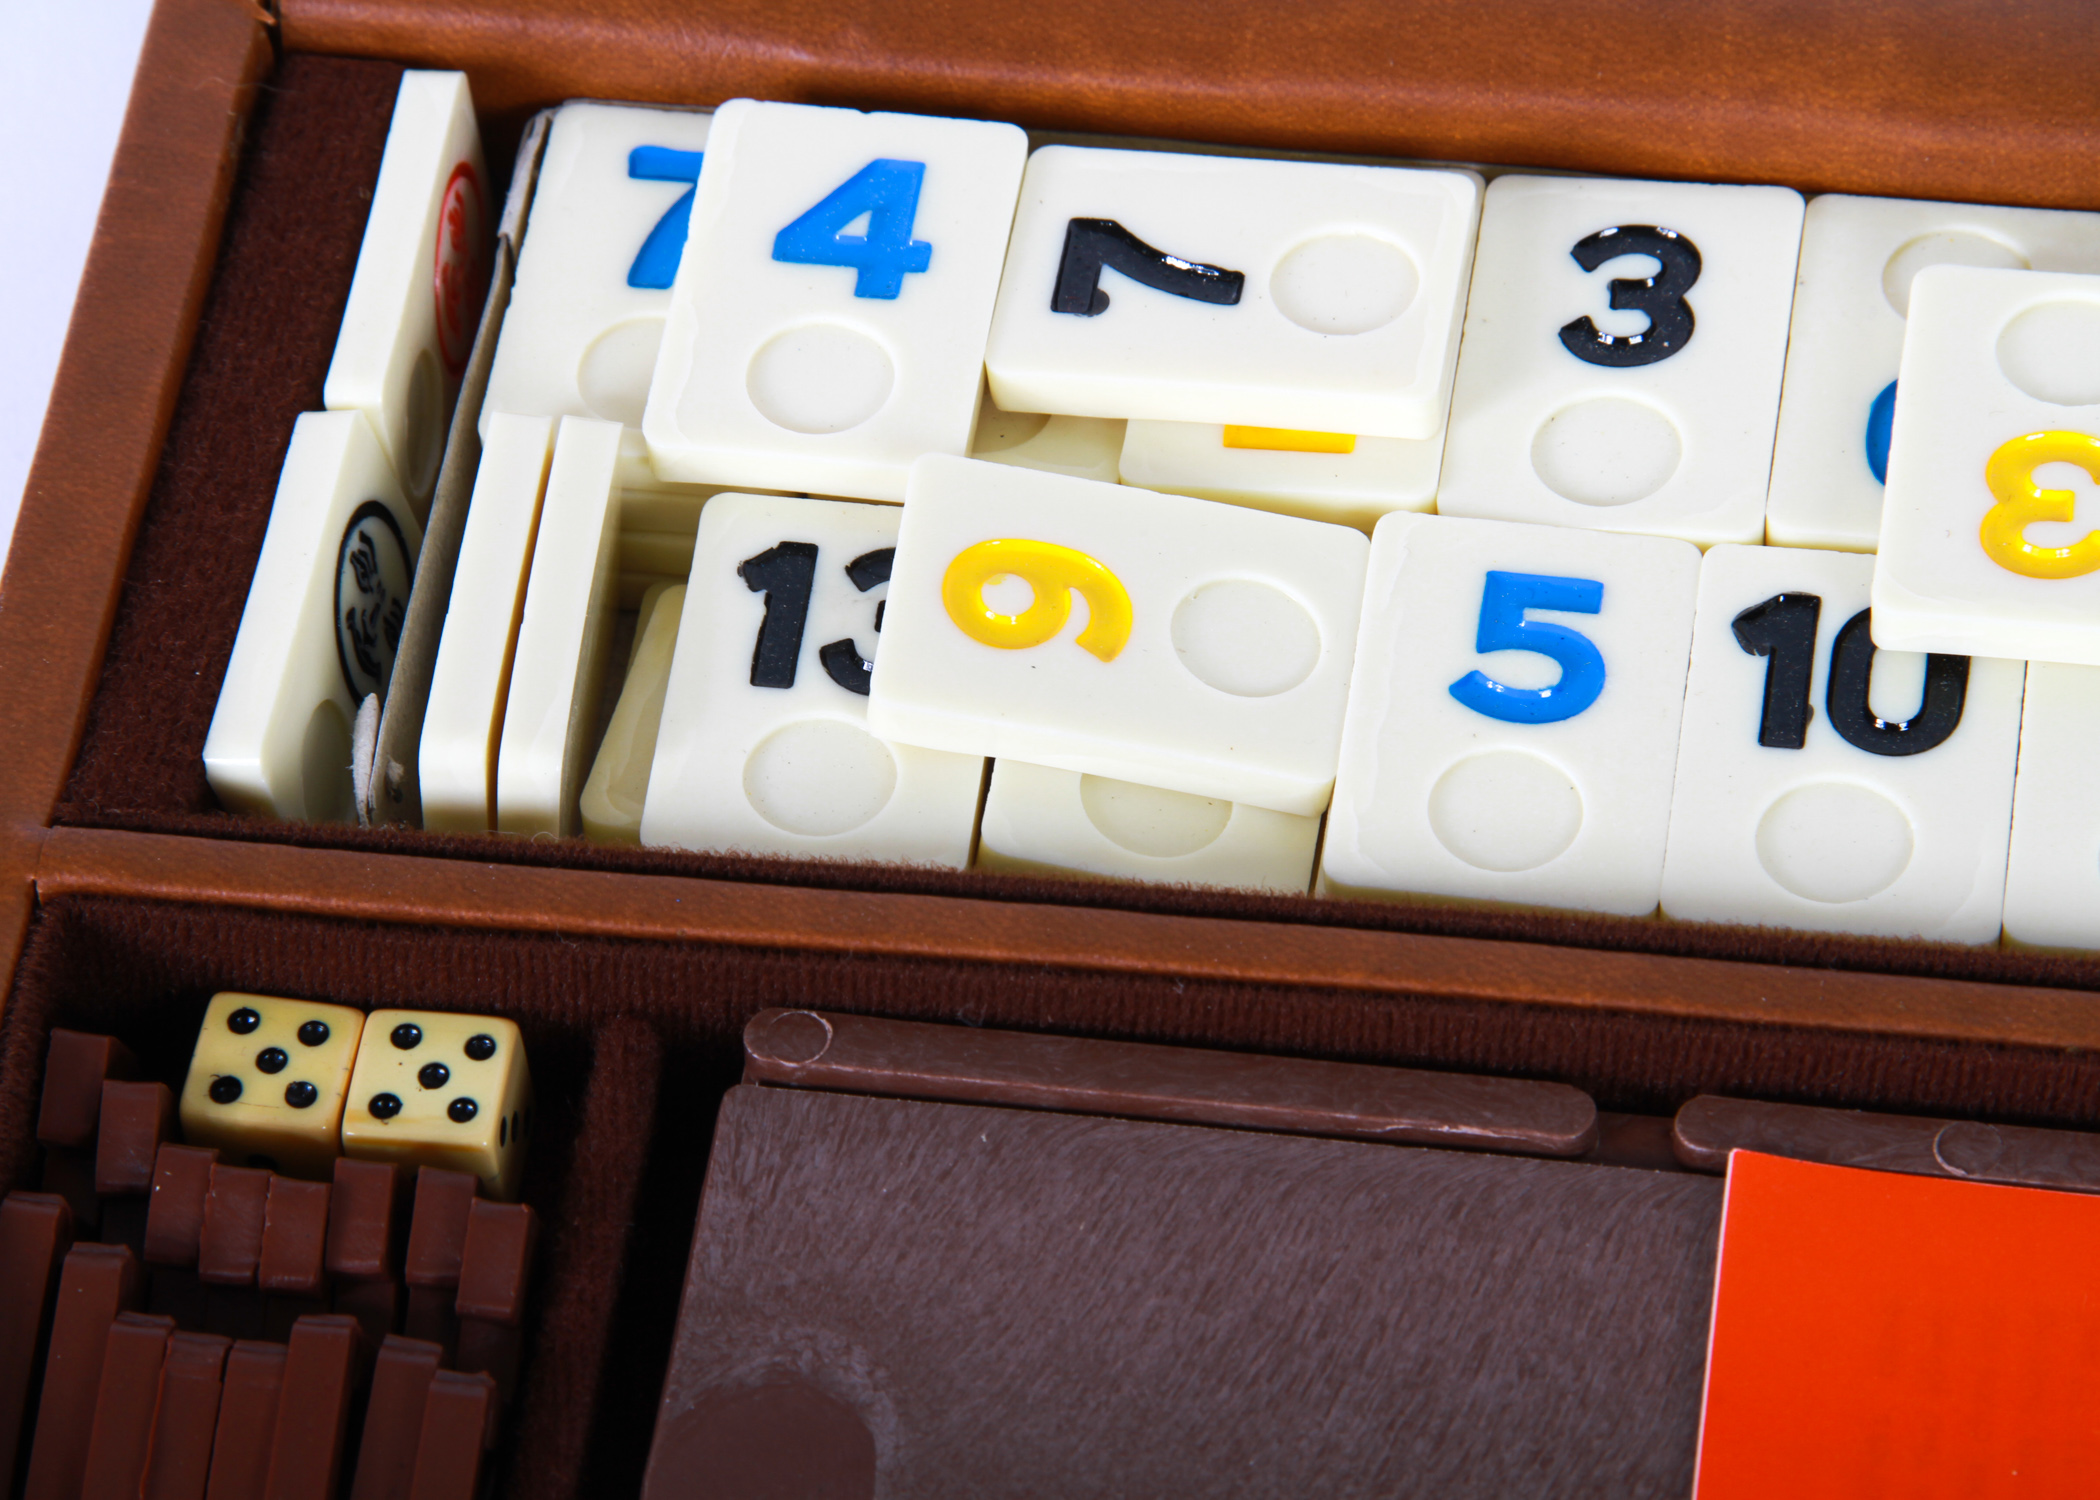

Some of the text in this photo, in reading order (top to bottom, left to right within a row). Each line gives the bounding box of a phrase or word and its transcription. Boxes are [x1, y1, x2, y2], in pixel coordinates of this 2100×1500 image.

[627, 145, 704, 290] 7
[772, 158, 932, 300] 4
[1051, 217, 1244, 317] 7
[1558, 224, 1702, 368] 3
[1979, 430, 2100, 580] 3
[941, 537, 1133, 663] 9
[1449, 570, 1606, 725] 5
[1732, 591, 1970, 757] 10
